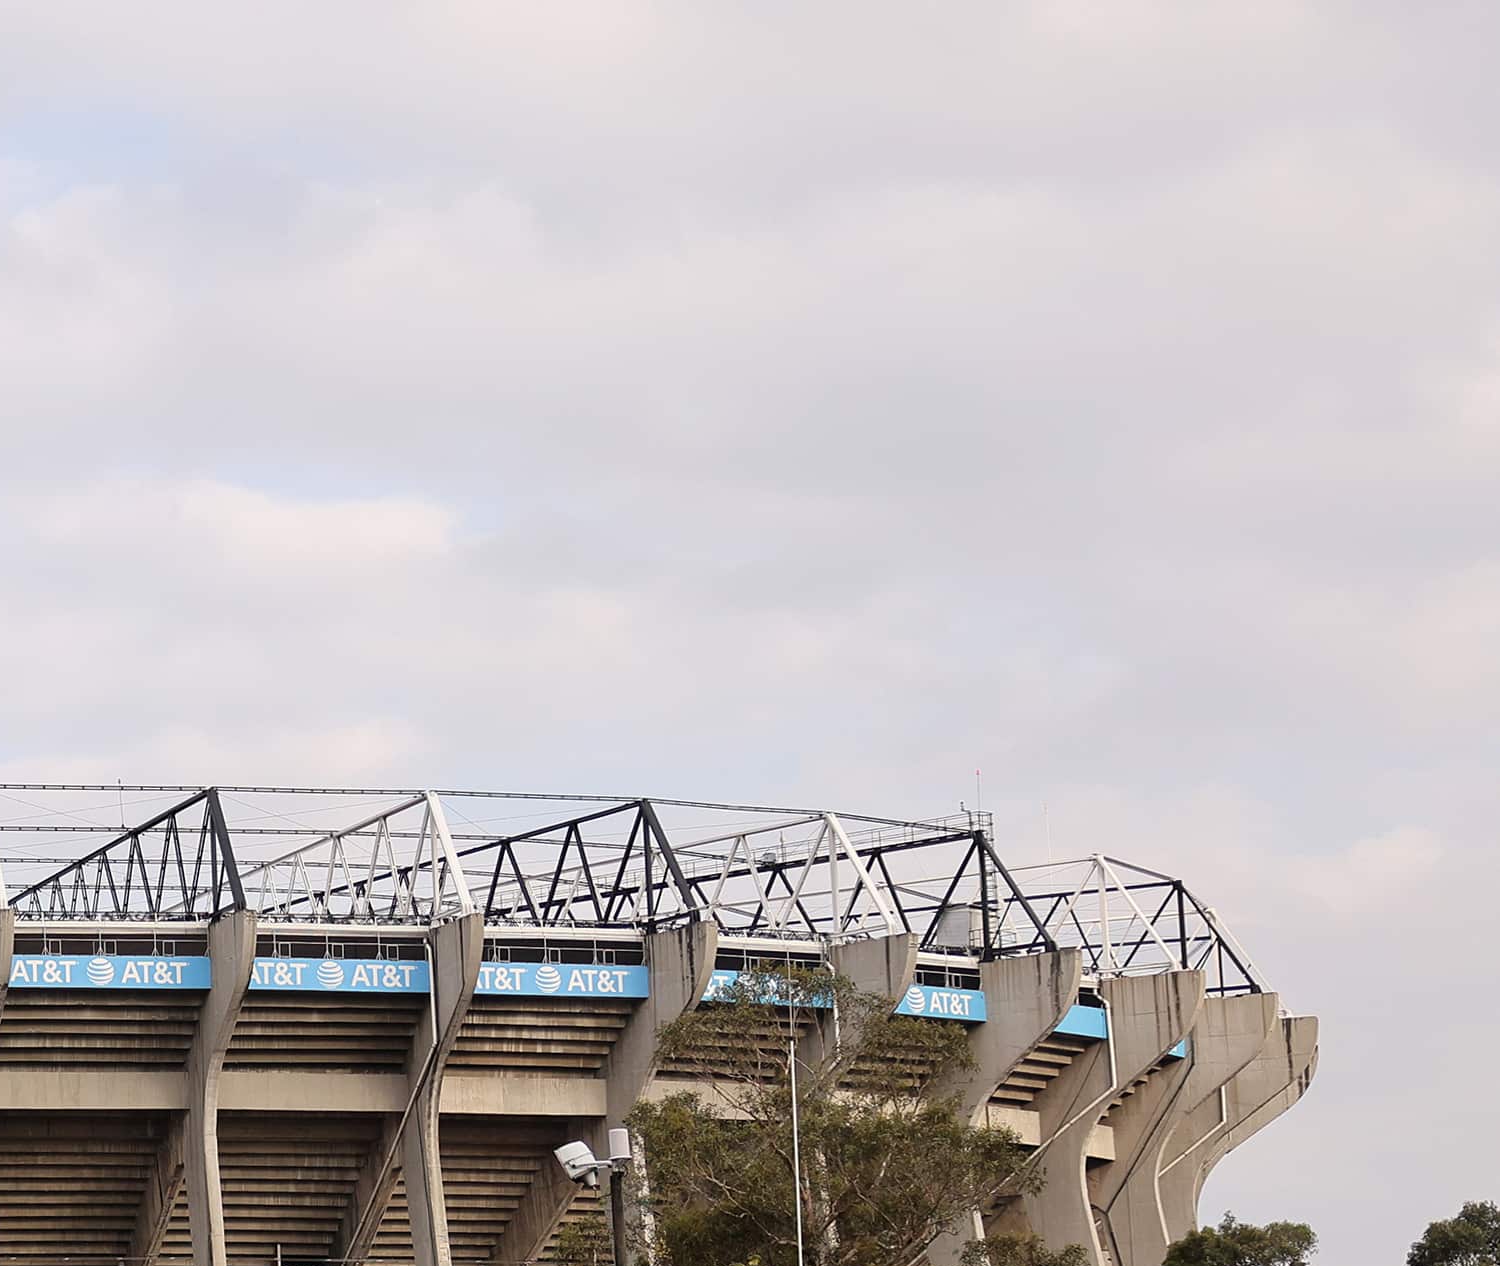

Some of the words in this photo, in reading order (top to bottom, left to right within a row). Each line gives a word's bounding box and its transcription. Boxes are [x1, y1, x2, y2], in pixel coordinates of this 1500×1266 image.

[10, 959, 77, 985] AT&T
[120, 959, 188, 985] AT&T
[350, 962, 416, 988] AT&T
[566, 967, 630, 993] AT&T
[930, 991, 972, 1017] AT&T
